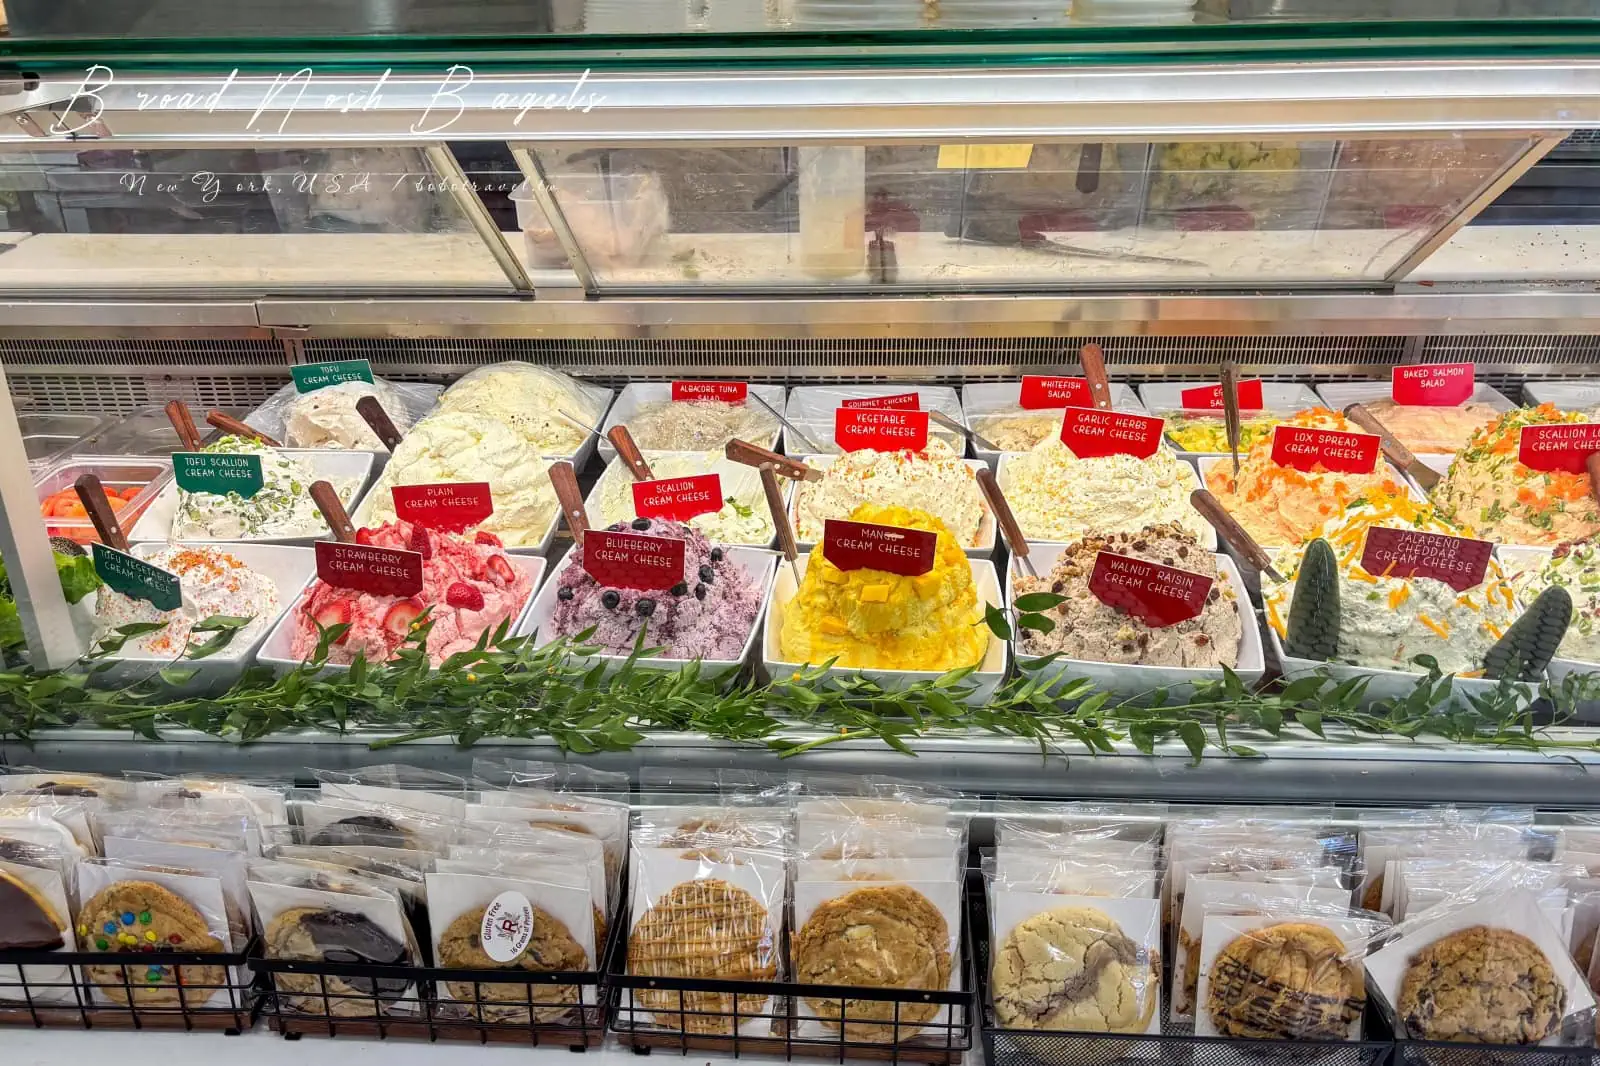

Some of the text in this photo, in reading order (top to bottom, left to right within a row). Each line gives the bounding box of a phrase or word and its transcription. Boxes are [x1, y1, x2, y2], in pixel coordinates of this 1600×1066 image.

[320, 366, 339, 374] TOFU
[1403, 368, 1464, 379] BAKED SALMON
[303, 373, 363, 385] CREAM CHEESE
[1041, 380, 1081, 390] WHITEFISH
[1420, 379, 1445, 388] SALAD
[680, 385, 738, 394] ALBACORE TUNA
[1047, 390, 1071, 399] SALAD
[848, 399, 880, 409] GOURMET
[884, 395, 913, 405] CHICKEN
[1210, 399, 1225, 408] SAL
[856, 413, 906, 425] VEGETABLE
[1078, 413, 1148, 430] GARLIC HERBS
[845, 425, 917, 437] CREAM CHEESE
[1072, 425, 1148, 442] CREAM CHEESE
[1539, 428, 1587, 440] SCALLION
[1295, 432, 1358, 447] LOX SPREAD
[1532, 439, 1600, 452] CREAM CHEE
[1285, 443, 1365, 460] CREAM CHEESE
[184, 457, 249, 467] TOFU SCALLION
[185, 469, 252, 478] CREAM CHEESE
[427, 488, 454, 497] PLAIN
[656, 481, 694, 494] SCALLION
[405, 497, 479, 508] CREAM CHEESE
[643, 491, 711, 507] CREAM CHEESE
[606, 537, 663, 553] BLUEBERRY
[836, 538, 921, 558] CREAM CHEESE
[1397, 543, 1457, 560] CHEDDAR
[335, 549, 402, 565] STRAWBERRY
[595, 550, 673, 568] CREAM CHEESE
[1375, 550, 1473, 573] CREAM CHEESE
[100, 549, 171, 585] TOFU VEGETABLE
[104, 561, 134, 580] CREAM
[329, 560, 409, 578] CREAM CHEESE
[1111, 559, 1194, 589] WALNUT RAISIN
[1104, 572, 1193, 601] CREAM CHEESE
[484, 902, 502, 941] Gluten Free
[515, 932, 528, 949] Grams
